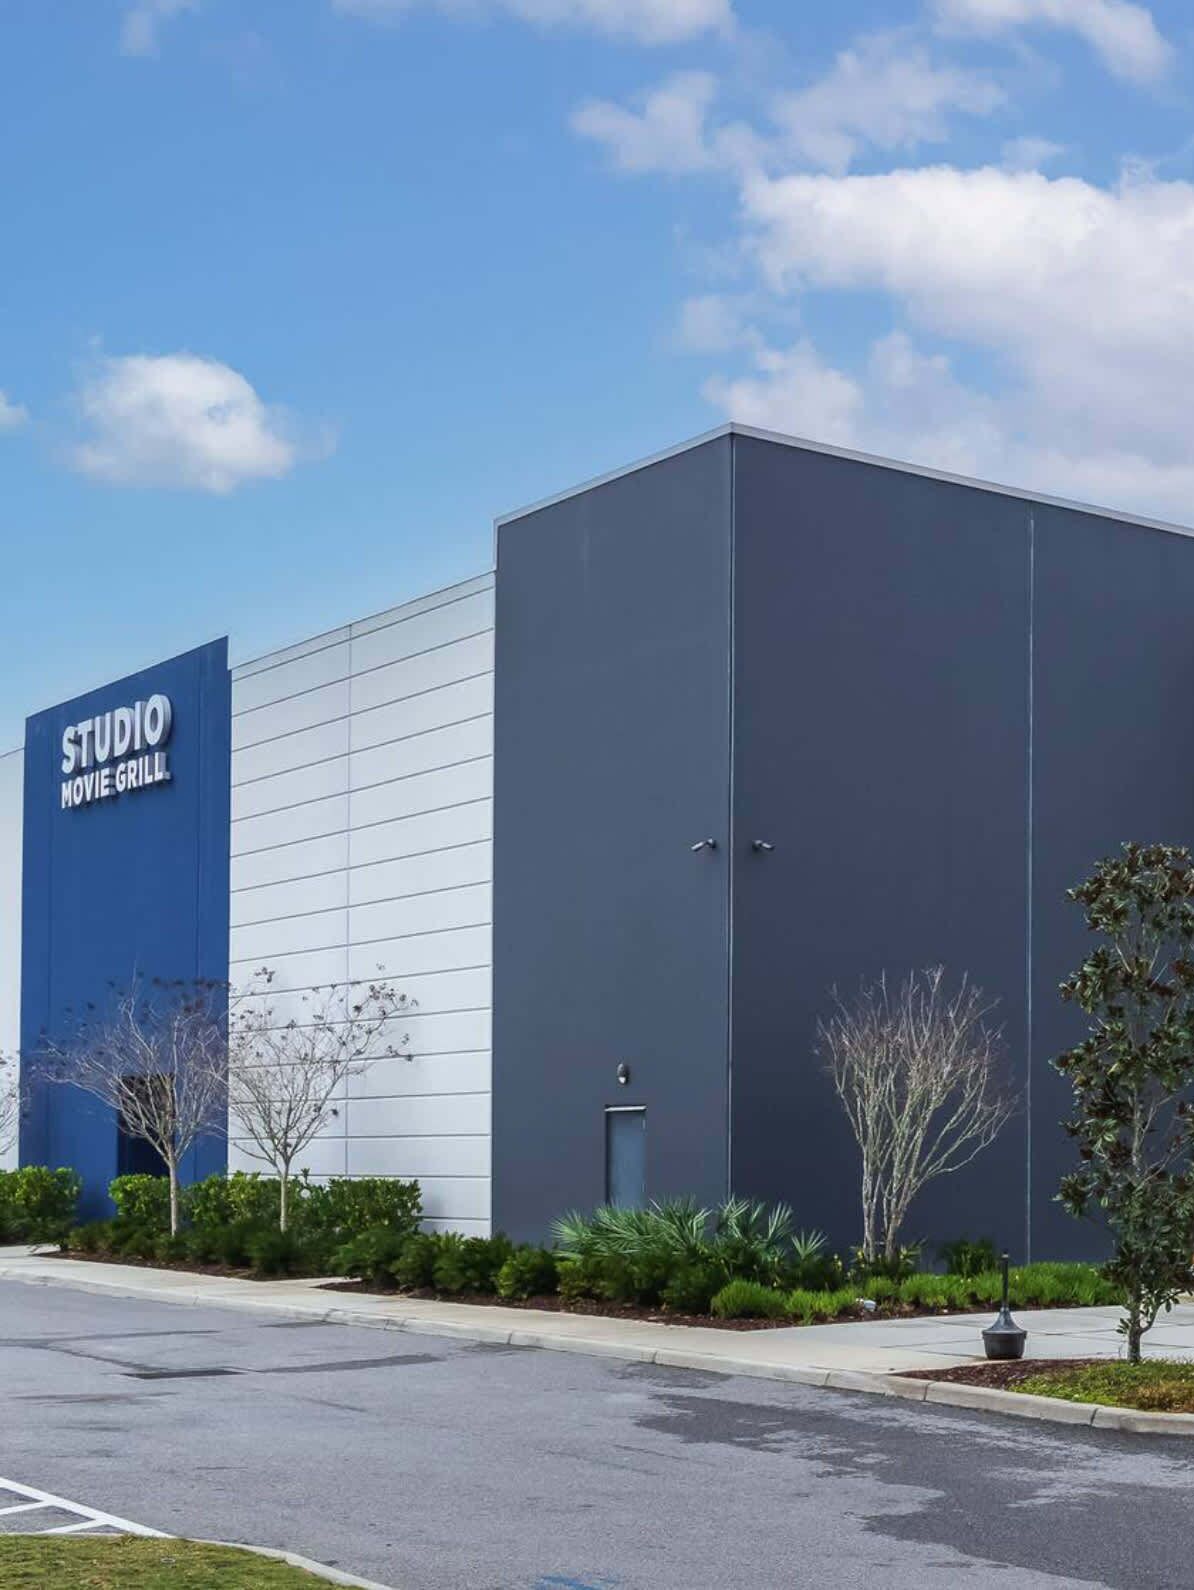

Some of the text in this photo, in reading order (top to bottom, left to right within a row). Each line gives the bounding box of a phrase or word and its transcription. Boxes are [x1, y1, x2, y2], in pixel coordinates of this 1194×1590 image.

[61, 694, 171, 774] STUDIO
[61, 752, 170, 808] MOVIE GRILL
